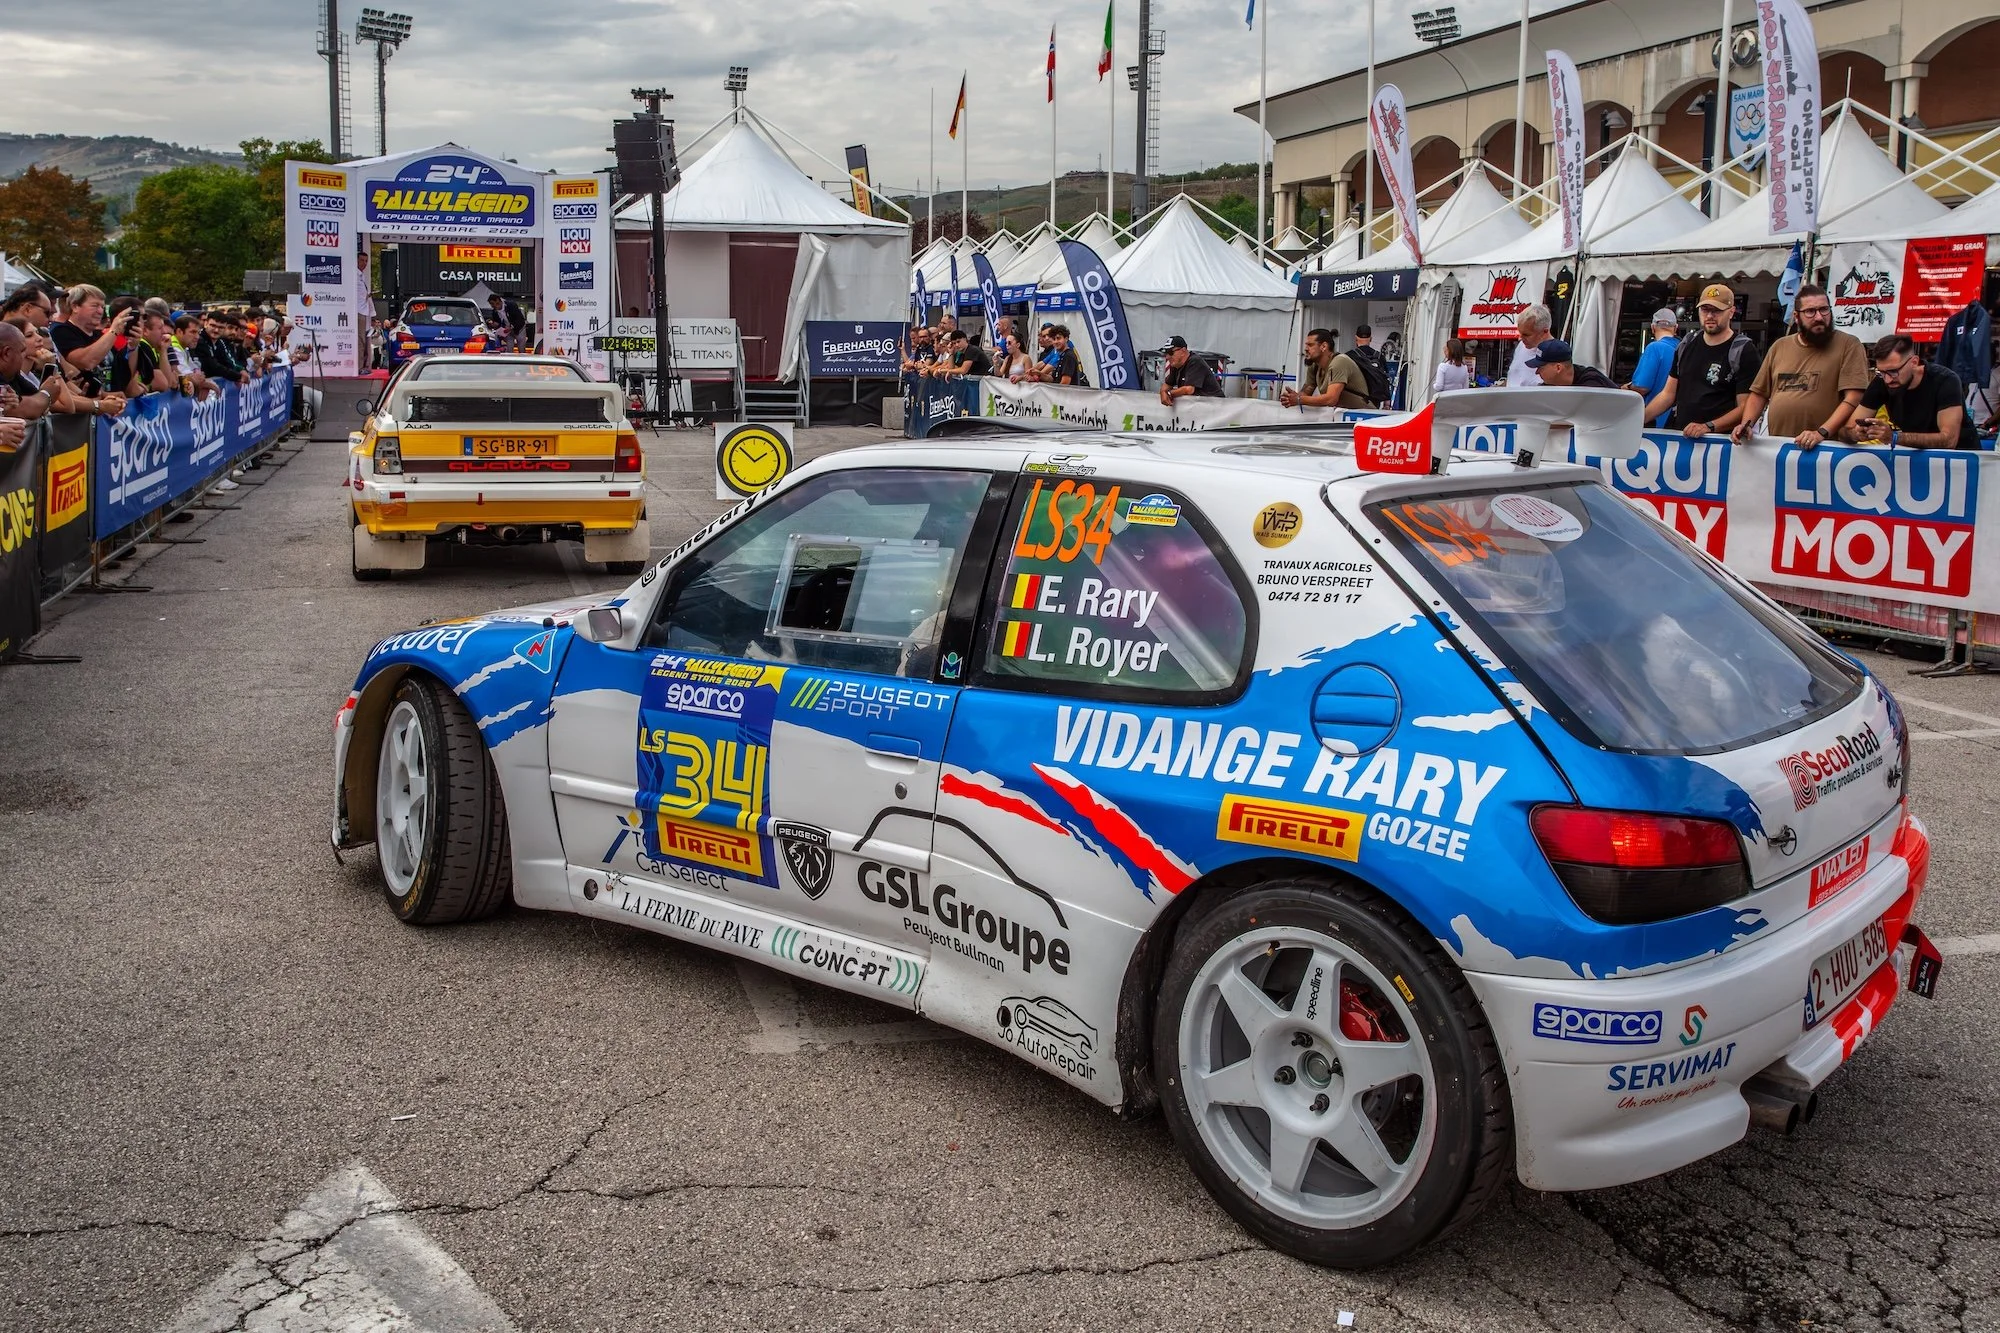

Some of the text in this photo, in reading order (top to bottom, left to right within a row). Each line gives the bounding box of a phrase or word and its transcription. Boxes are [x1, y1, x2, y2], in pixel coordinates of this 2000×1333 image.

[1733, 93, 1746, 102] SAN
[302, 171, 344, 188] PIRELLI
[556, 183, 595, 195] PIRELLI
[301, 195, 345, 211] sparco
[371, 190, 529, 214] RALLYLEGEND
[554, 204, 596, 218] sparco
[308, 221, 338, 233] LIQUI
[376, 213, 440, 222] REPUBBLICA
[308, 234, 338, 247] MOLY
[561, 229, 590, 240] LIQUI
[446, 244, 513, 259] PIRELLI
[561, 241, 590, 253] MOLY
[1952, 244, 1963, 252] 360
[439, 270, 522, 282] CASA PIRELLI
[1333, 276, 1367, 296] EBERHARD
[305, 316, 322, 325] TIM
[558, 321, 574, 329] TIM
[617, 325, 657, 335] GIOCH
[602, 338, 655, 352] 12:46:55
[618, 350, 657, 359] GIOCH
[672, 350, 687, 359] EL
[823, 339, 882, 354] EBERHARD
[109, 407, 173, 505] sparco
[1366, 437, 1422, 462] Rary
[449, 461, 571, 473] quattro
[1378, 457, 1405, 465] RACING
[51, 459, 85, 515] PIRELLI
[1784, 450, 1967, 518] LIQUI
[0, 488, 35, 554] CING
[1015, 479, 1121, 566] LS34
[1271, 532, 1293, 540] SUMMIT
[1381, 503, 1507, 567] LS34
[1780, 514, 1971, 588] MOLY
[1264, 560, 1373, 573] TRAVAUX AGRICOLES
[1257, 574, 1374, 588] BRUNO VERSPREET
[1037, 575, 1159, 628] E. Rary
[1268, 591, 1362, 603] 0474 72 81 17
[1028, 623, 1169, 678] L. Royer
[651, 668, 753, 688] LEGEND STARS 2026
[685, 658, 764, 680] RALLYLEGEND
[665, 683, 745, 717] sparco
[826, 681, 951, 711] PEUGEOT
[815, 696, 900, 721] SPORT
[1800, 721, 1881, 782] SecuRoad
[1053, 705, 1507, 827] VIDANGE RARY
[1816, 779, 1837, 798] Traffic
[1837, 768, 1861, 791] products
[1866, 754, 1884, 773] services
[639, 727, 769, 832] LS 34
[778, 827, 826, 844] PEUGEOT
[1229, 801, 1351, 849] PIRELLI
[665, 820, 752, 866] PIRELLI
[1367, 811, 1471, 864] GOZEE
[620, 892, 763, 949] LA FERME DU PAVE
[857, 861, 1071, 976] GSL Groupe
[903, 916, 1005, 973] Peugeot Bullman
[1306, 966, 1324, 1021] speedline
[1536, 1004, 1661, 1043] sparco
[1804, 1003, 1814, 1024] B
[1016, 1028, 1098, 1082] AutoRepair
[1607, 1042, 1737, 1091] SERVIMAT
[1617, 1096, 1638, 1109] Un
[1639, 1091, 1674, 1108] service
